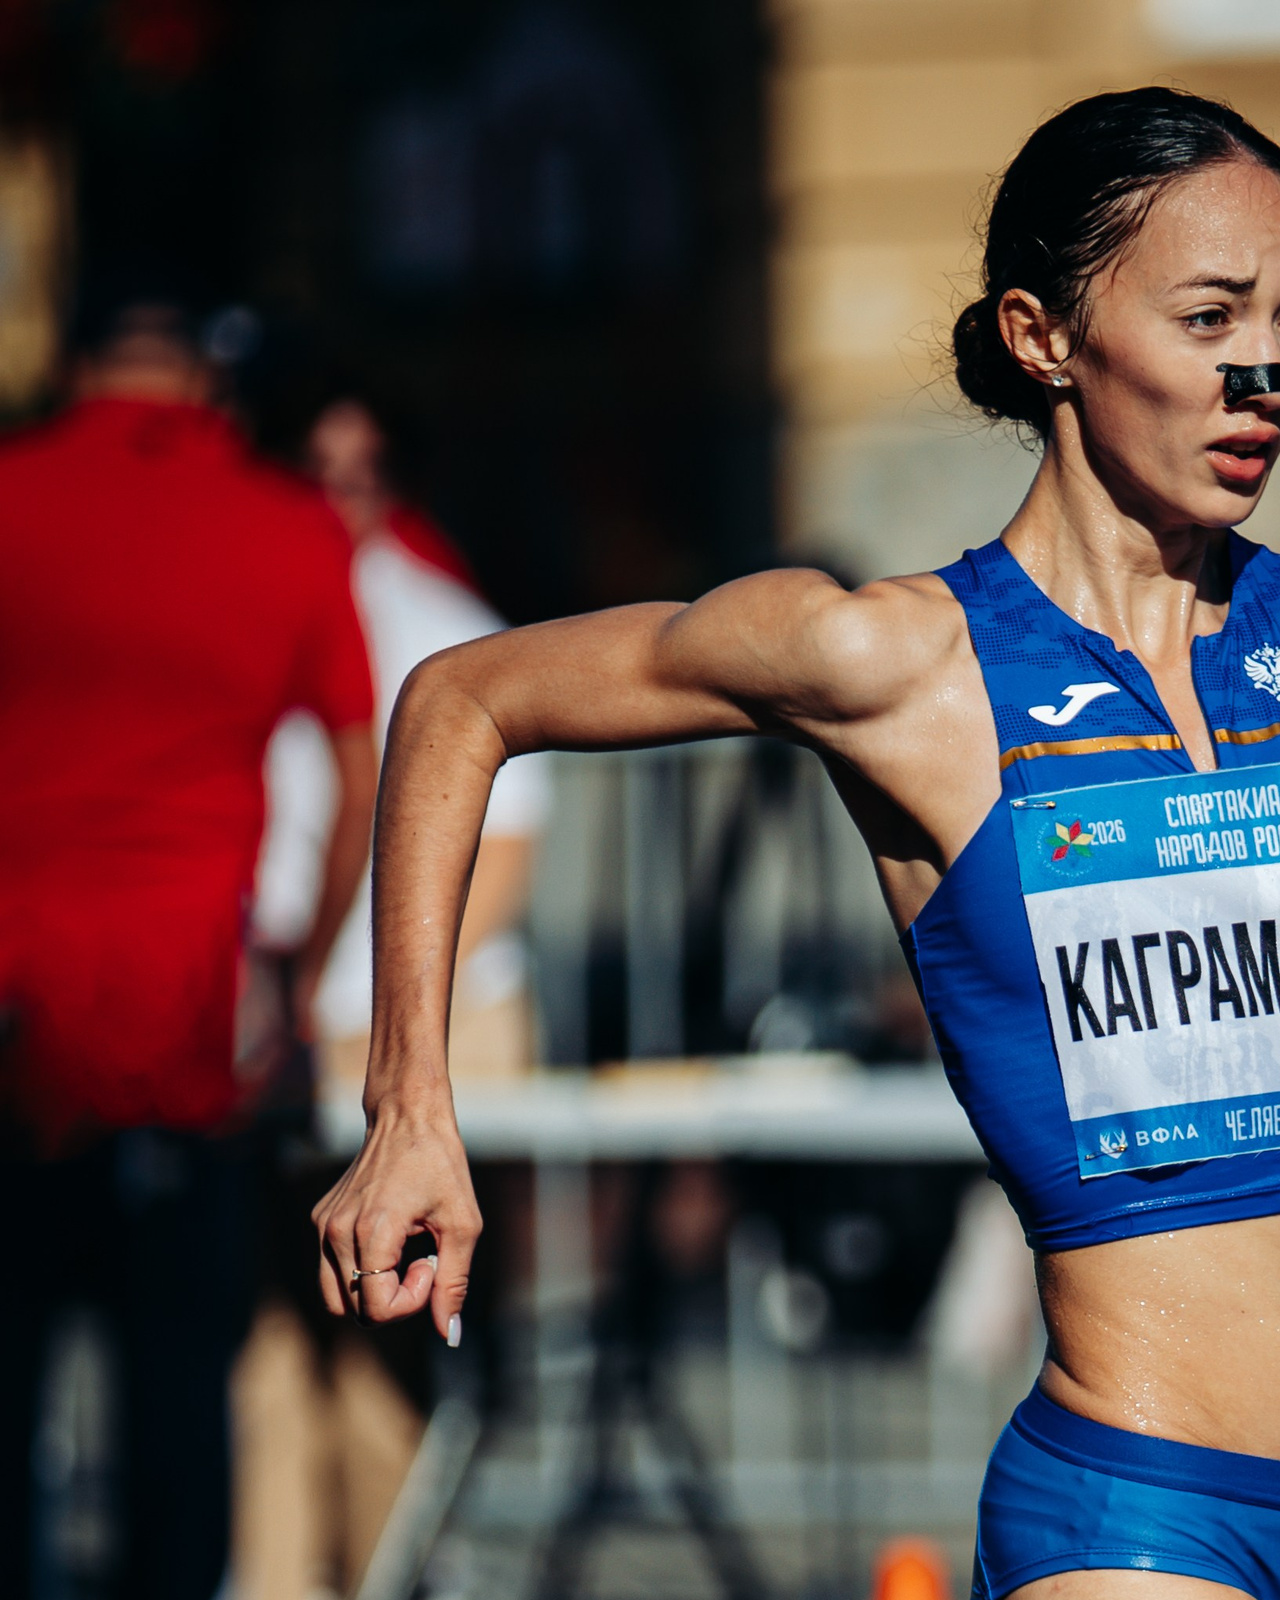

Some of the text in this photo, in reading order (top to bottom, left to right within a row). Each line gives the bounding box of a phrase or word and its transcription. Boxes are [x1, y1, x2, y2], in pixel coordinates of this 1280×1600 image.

[1087, 818, 1127, 846] 2026
[1155, 829, 1248, 868] НАРОДОВ
[1135, 1123, 1199, 1147] ВФЛА
